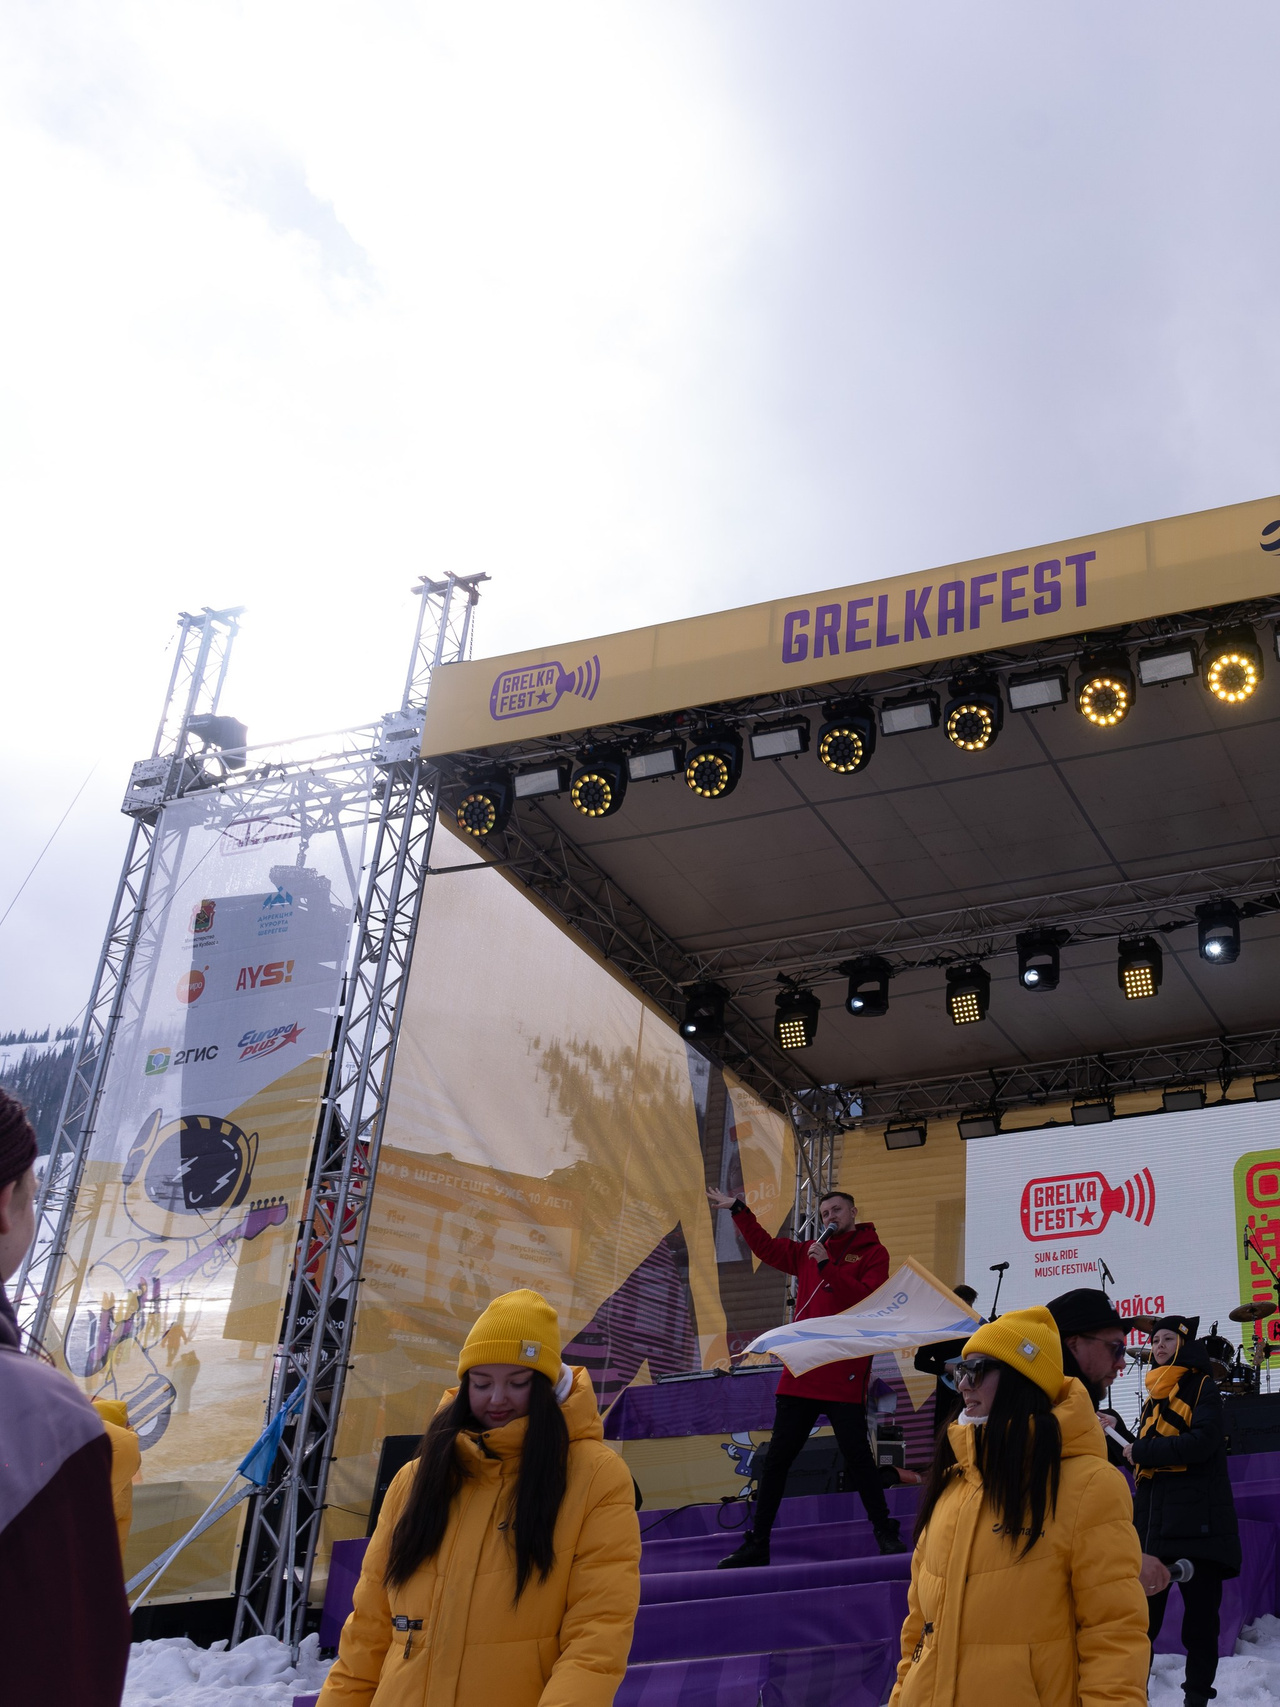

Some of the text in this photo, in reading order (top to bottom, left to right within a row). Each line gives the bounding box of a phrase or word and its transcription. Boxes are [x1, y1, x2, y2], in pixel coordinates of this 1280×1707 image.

[781, 551, 1097, 664] GRELKAFEST
[502, 669, 554, 694] GRELKA
[500, 690, 535, 713] FEST
[257, 911, 293, 922] ДИРЕКЦИЯ
[260, 920, 288, 929] КУРОРТА
[258, 926, 288, 936] ШЕРЕГЕШ
[236, 959, 295, 992] AYS!
[237, 1023, 295, 1047] Europa
[174, 1045, 219, 1066] 2ГИС
[414, 1168, 490, 1194] ШЕРЕГЕШЕ
[494, 1184, 524, 1200] УЖЕ
[529, 1193, 541, 1204] 10
[544, 1196, 573, 1210] ЛЕТ!
[1034, 1181, 1097, 1208] GRELKA
[1034, 1207, 1077, 1232] FEST
[529, 1229, 546, 1245] Ср
[520, 1253, 552, 1264] концерт
[1034, 1249, 1079, 1263] SUN & RIDE
[1034, 1261, 1098, 1278] MUSIC FESTIVAL
